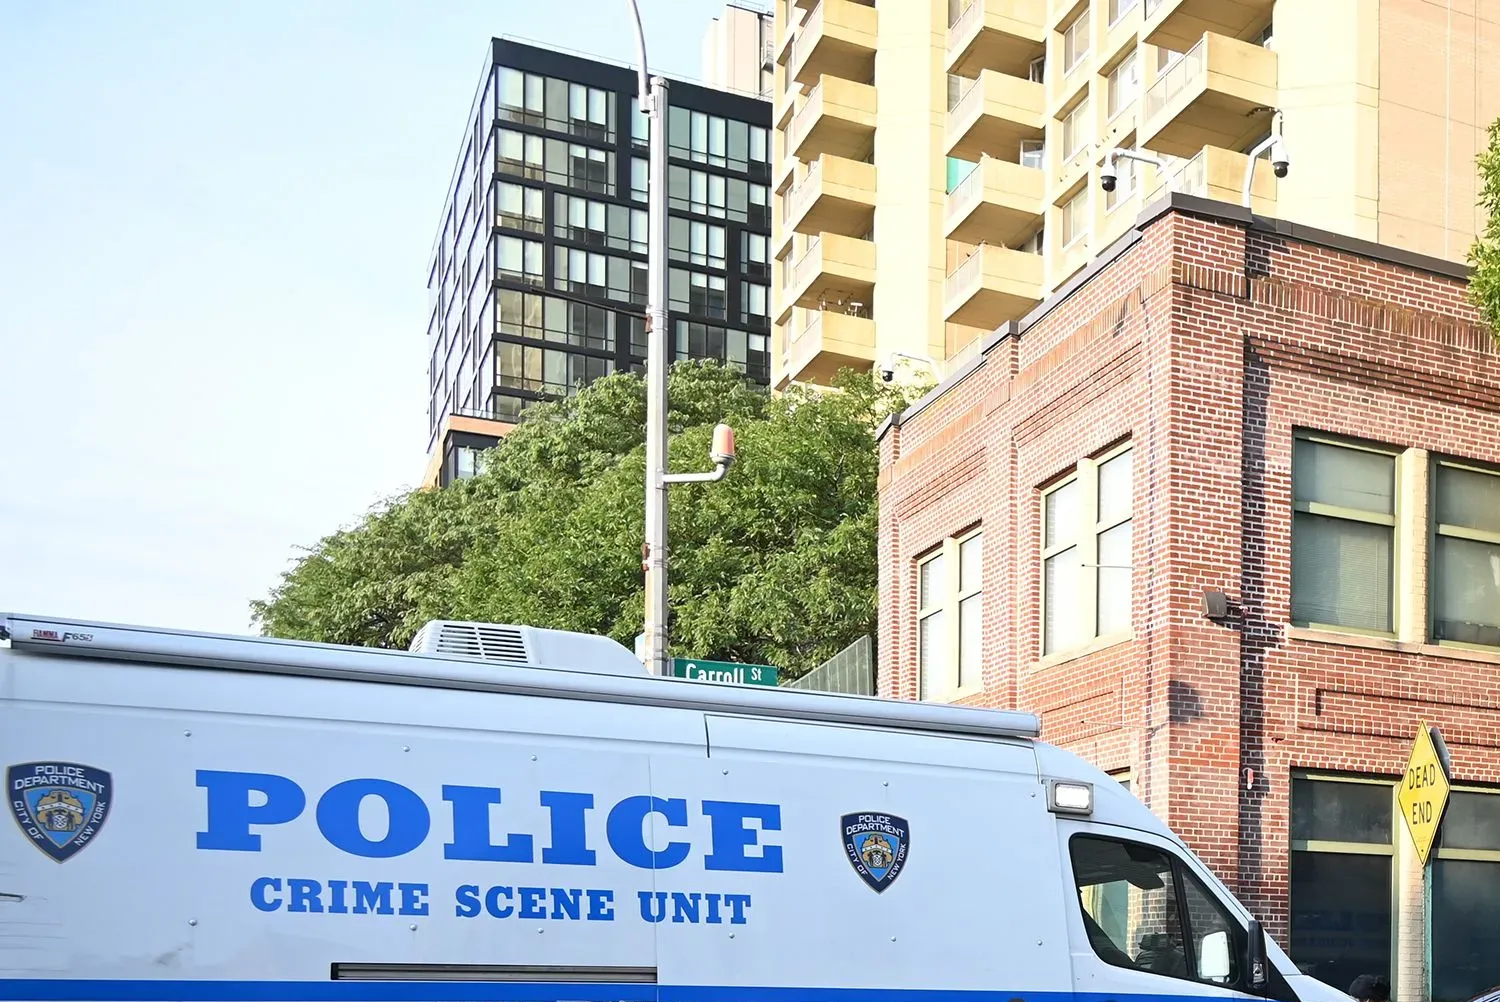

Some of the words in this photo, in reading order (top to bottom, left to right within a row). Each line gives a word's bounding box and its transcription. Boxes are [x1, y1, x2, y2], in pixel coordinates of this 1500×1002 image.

[686, 663, 744, 684] Carroll
[751, 667, 762, 681] St
[15, 775, 105, 794] DEPARTMENT
[35, 766, 84, 778] POLICE
[1408, 763, 1436, 790] DEAD
[14, 801, 32, 825] CITY
[28, 827, 44, 841] OF
[74, 825, 95, 846] NEW
[91, 801, 106, 824] YORK
[196, 769, 783, 873] POLICE
[859, 815, 891, 825] POLICE
[1412, 801, 1432, 825] END
[846, 823, 904, 837] DEPARTMENT
[847, 843, 859, 863] CITY
[857, 864, 868, 876] OF
[887, 863, 900, 879] NEW
[897, 843, 906, 861] YORK
[250, 877, 430, 916] CRIME
[455, 884, 615, 921] SCENE
[639, 890, 752, 925] UNIT
